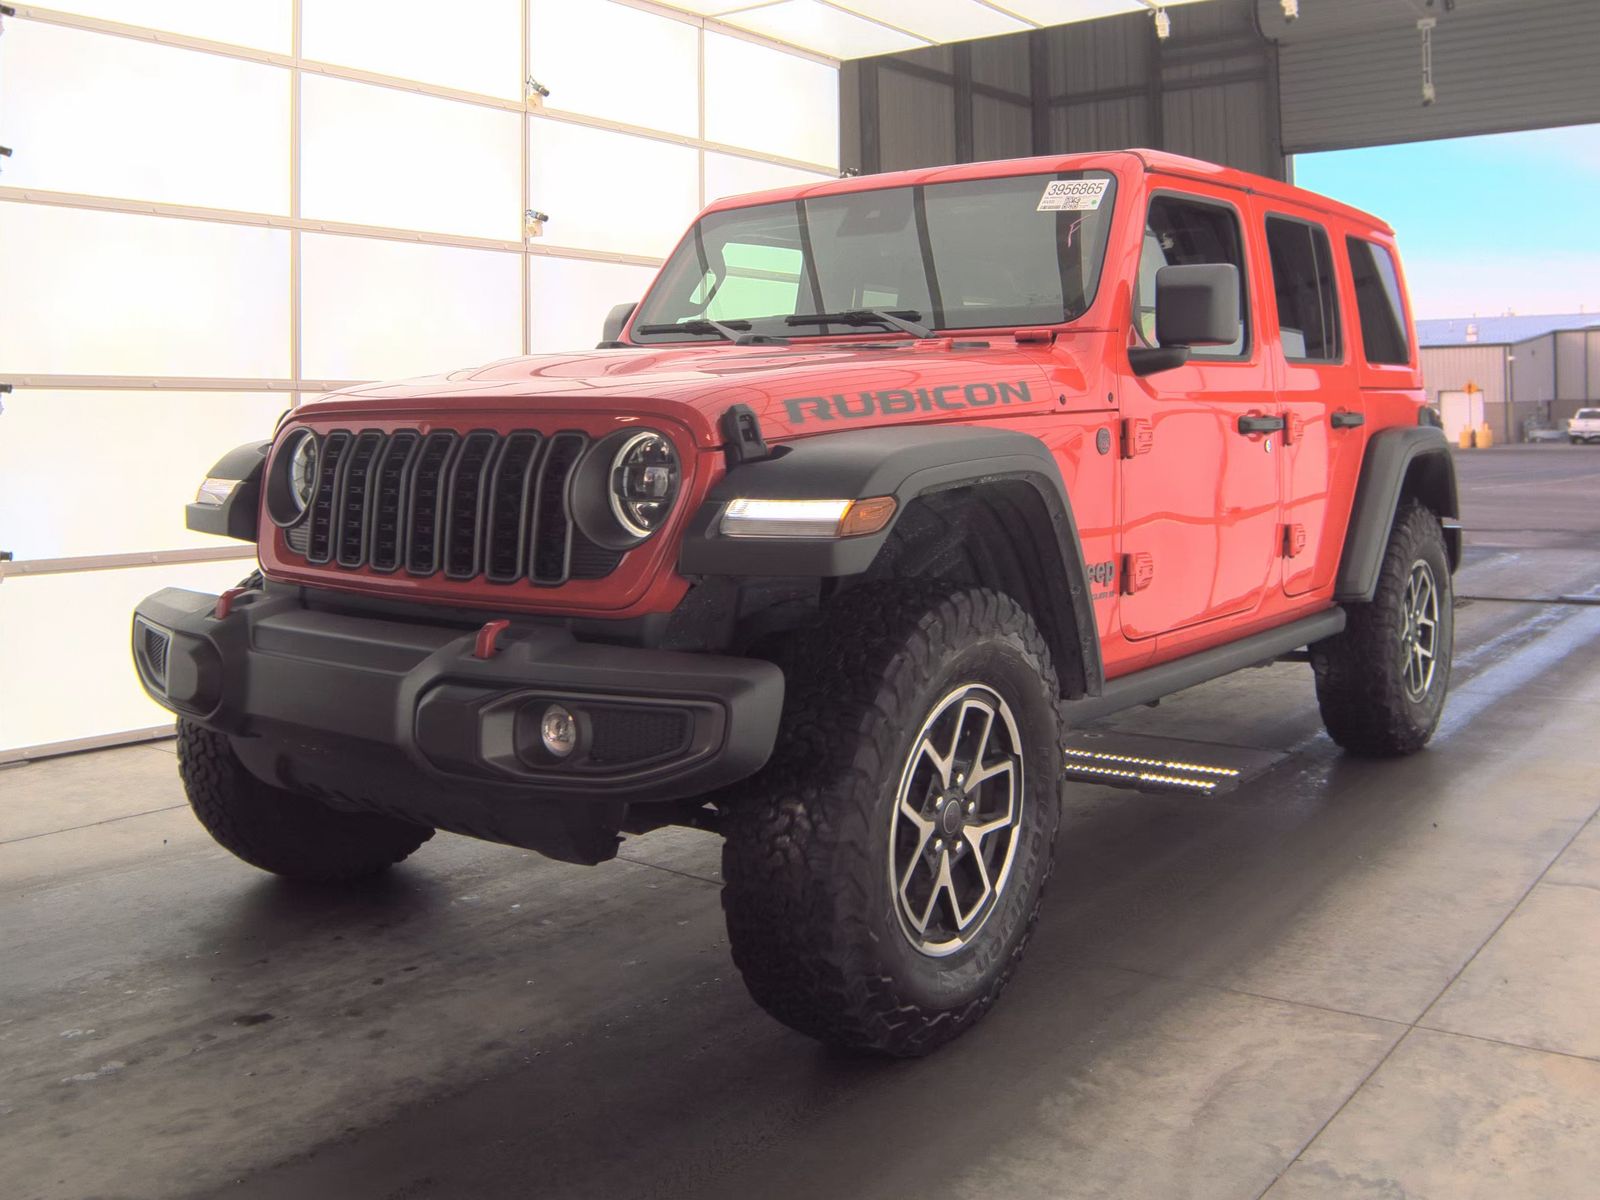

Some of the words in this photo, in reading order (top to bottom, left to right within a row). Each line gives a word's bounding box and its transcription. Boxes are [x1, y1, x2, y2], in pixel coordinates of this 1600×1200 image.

[1048, 183, 1104, 196] 3956865
[785, 380, 1031, 424] RUBICON
[1087, 561, 1115, 588] eep
